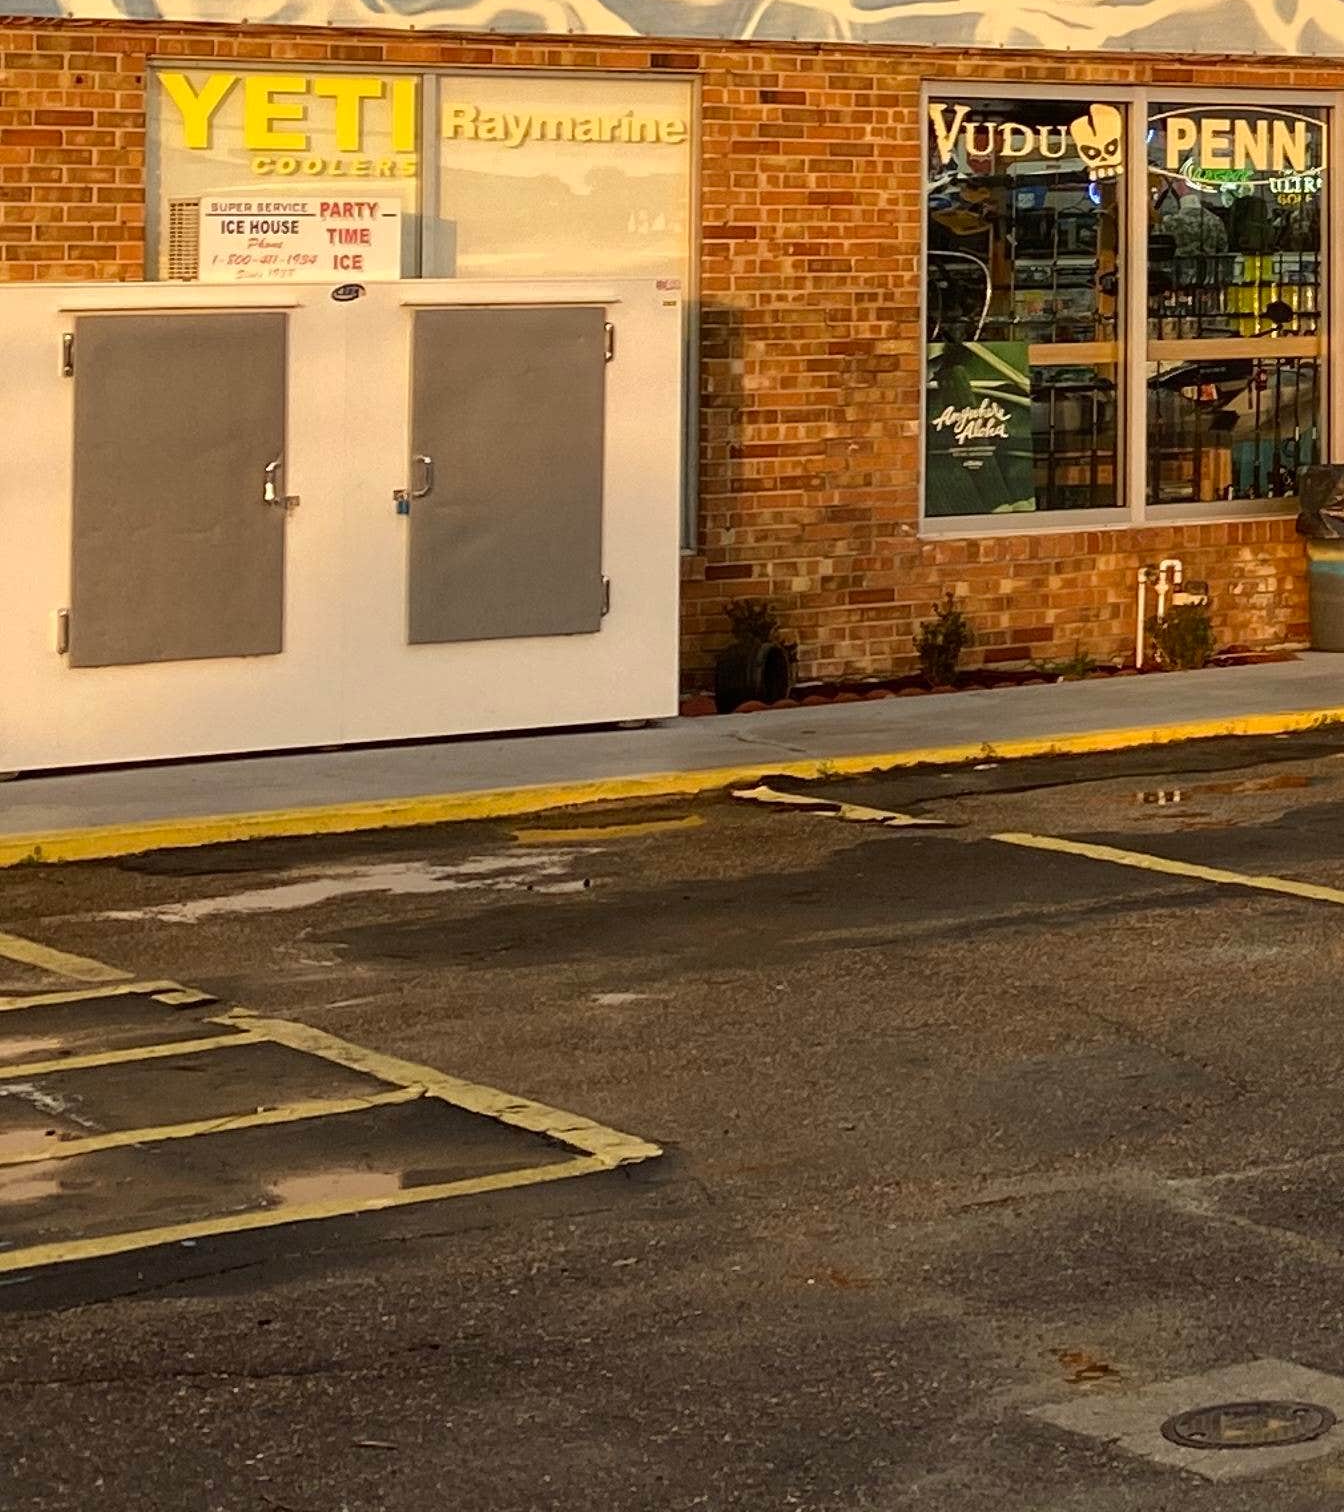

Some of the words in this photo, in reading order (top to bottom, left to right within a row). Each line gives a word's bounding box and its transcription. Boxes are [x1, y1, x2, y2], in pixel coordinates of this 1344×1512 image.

[156, 71, 417, 153] YETI
[442, 103, 688, 149] Raymarine
[1167, 118, 1306, 171] PENN
[252, 156, 417, 177] COOLERS
[211, 202, 252, 212] SUPER
[257, 202, 308, 212] SERVICE
[320, 202, 378, 219] PARTY
[221, 220, 245, 234] ICE
[249, 220, 299, 234] HOUSE
[326, 228, 371, 245] TIME
[333, 255, 362, 270] ICE
